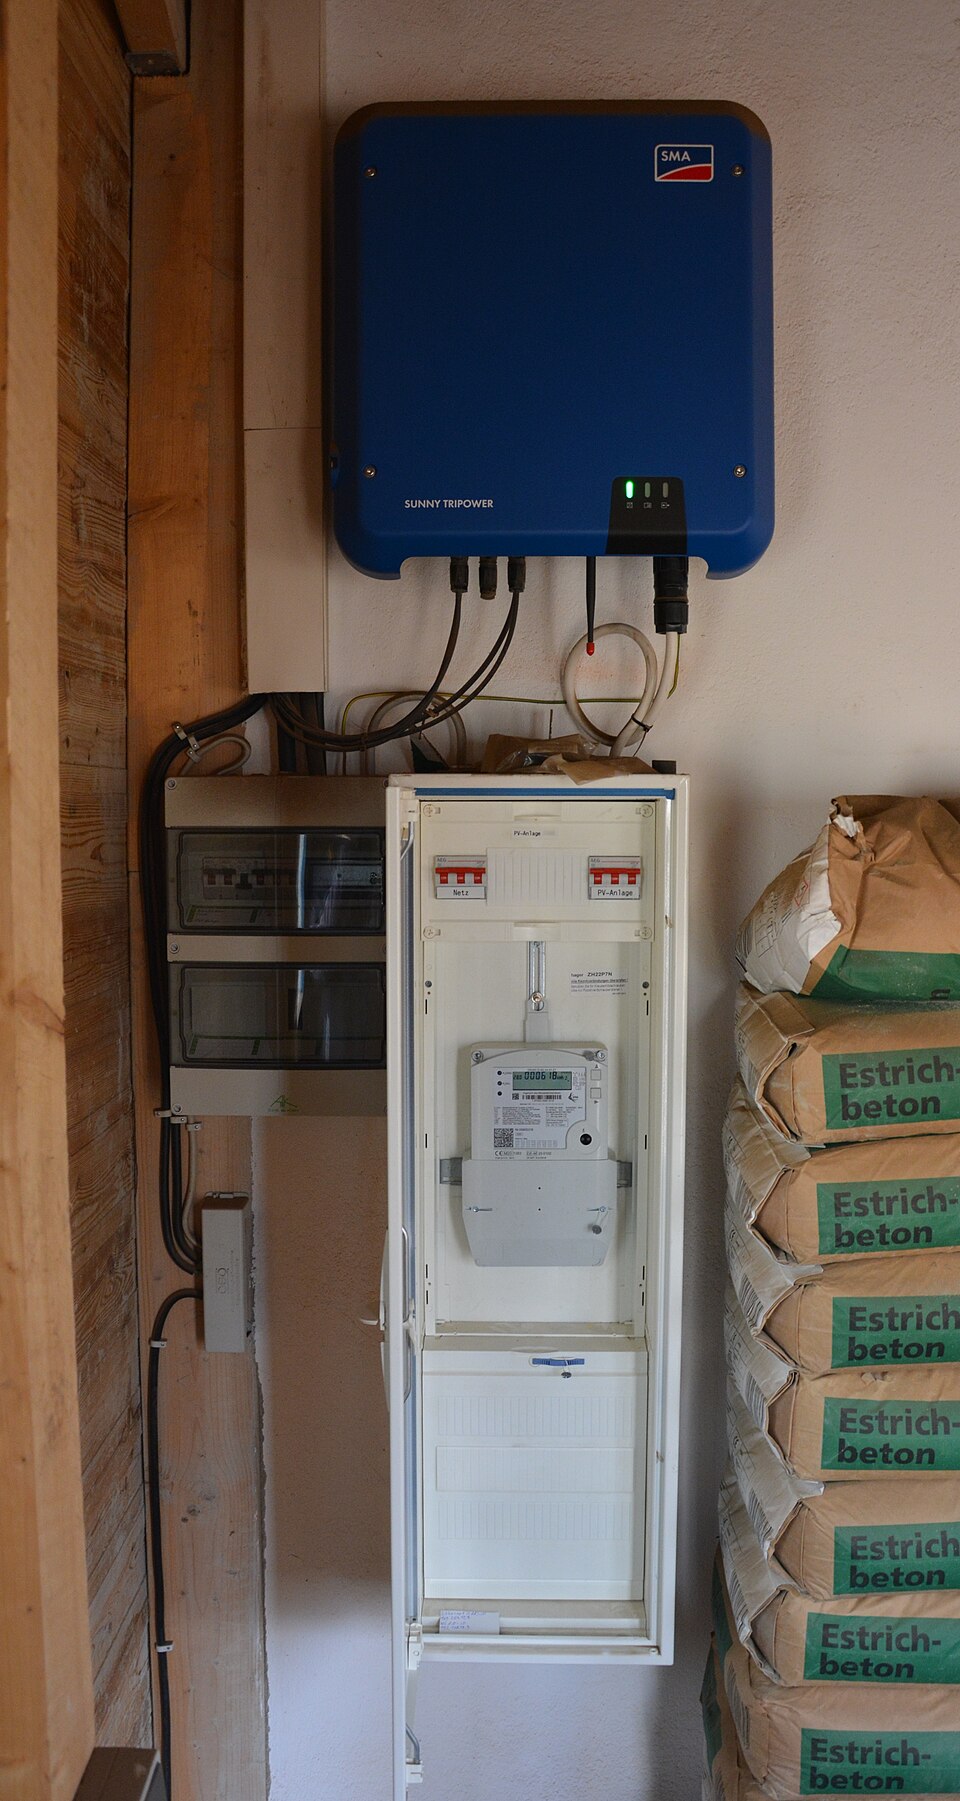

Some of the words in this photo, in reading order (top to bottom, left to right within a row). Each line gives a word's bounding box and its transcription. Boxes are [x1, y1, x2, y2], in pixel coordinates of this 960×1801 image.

[661, 150, 691, 162] SMA
[404, 499, 441, 509] SUNNY
[443, 499, 494, 509] TRIPOWER
[597, 889, 634, 897] PV-Anlage
[841, 1094, 941, 1121] beton
[834, 1185, 959, 1217] Estrich-
[834, 1222, 933, 1249] beton
[849, 1302, 960, 1332] Estrich
[847, 1336, 946, 1361] beton
[840, 1407, 960, 1436] Estrich-
[837, 1438, 936, 1465] beton
[850, 1530, 960, 1561] Estrich
[849, 1564, 946, 1589] beton
[821, 1623, 942, 1652] Estrich-
[819, 1652, 915, 1679] beton
[810, 1737, 931, 1767] Estrich-
[809, 1766, 905, 1790] beton
